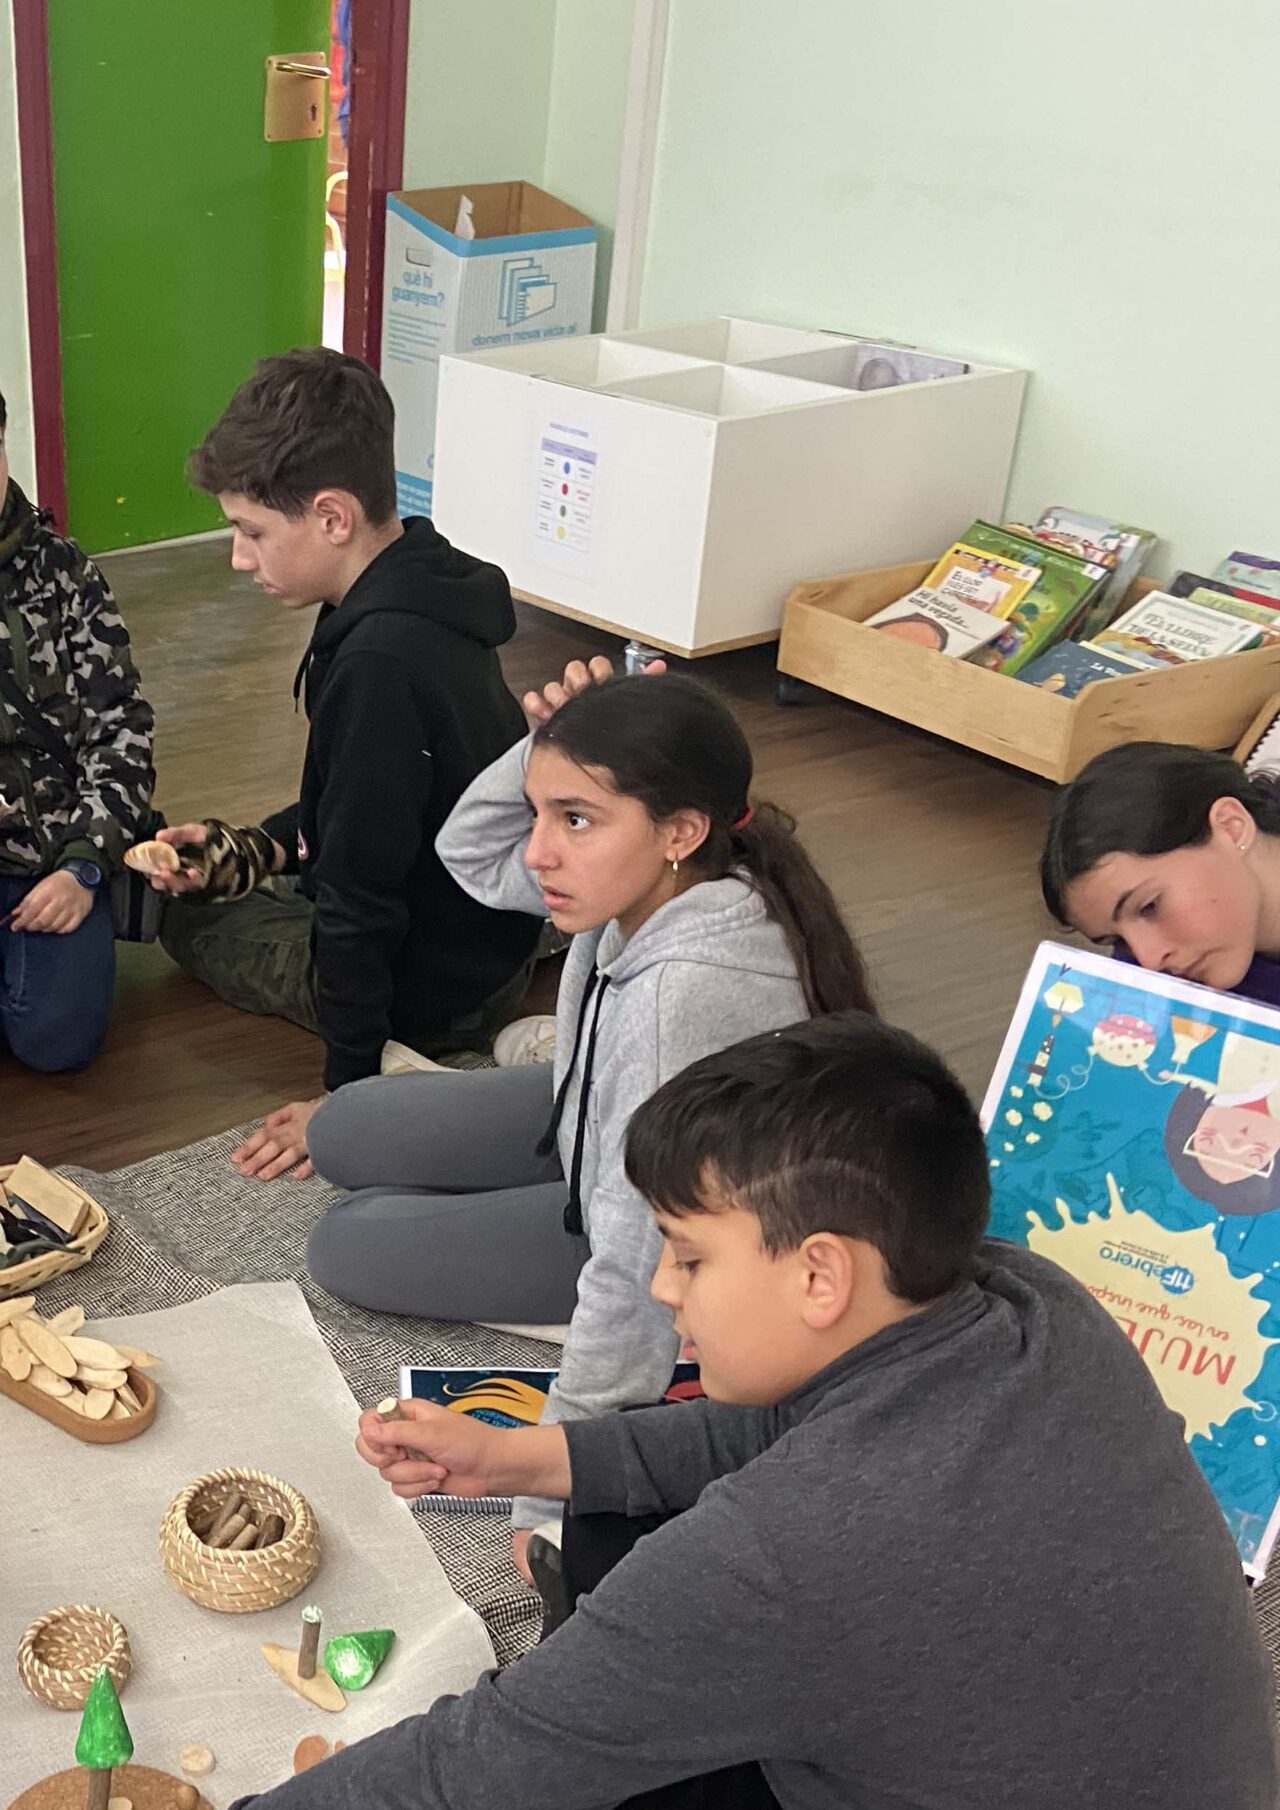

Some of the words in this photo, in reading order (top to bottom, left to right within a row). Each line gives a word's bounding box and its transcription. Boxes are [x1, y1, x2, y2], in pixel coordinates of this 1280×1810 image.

[908, 596, 929, 609] una
[1135, 1303, 1170, 1320] que
[1174, 1315, 1204, 1338] las
[1206, 1326, 1229, 1341] en
